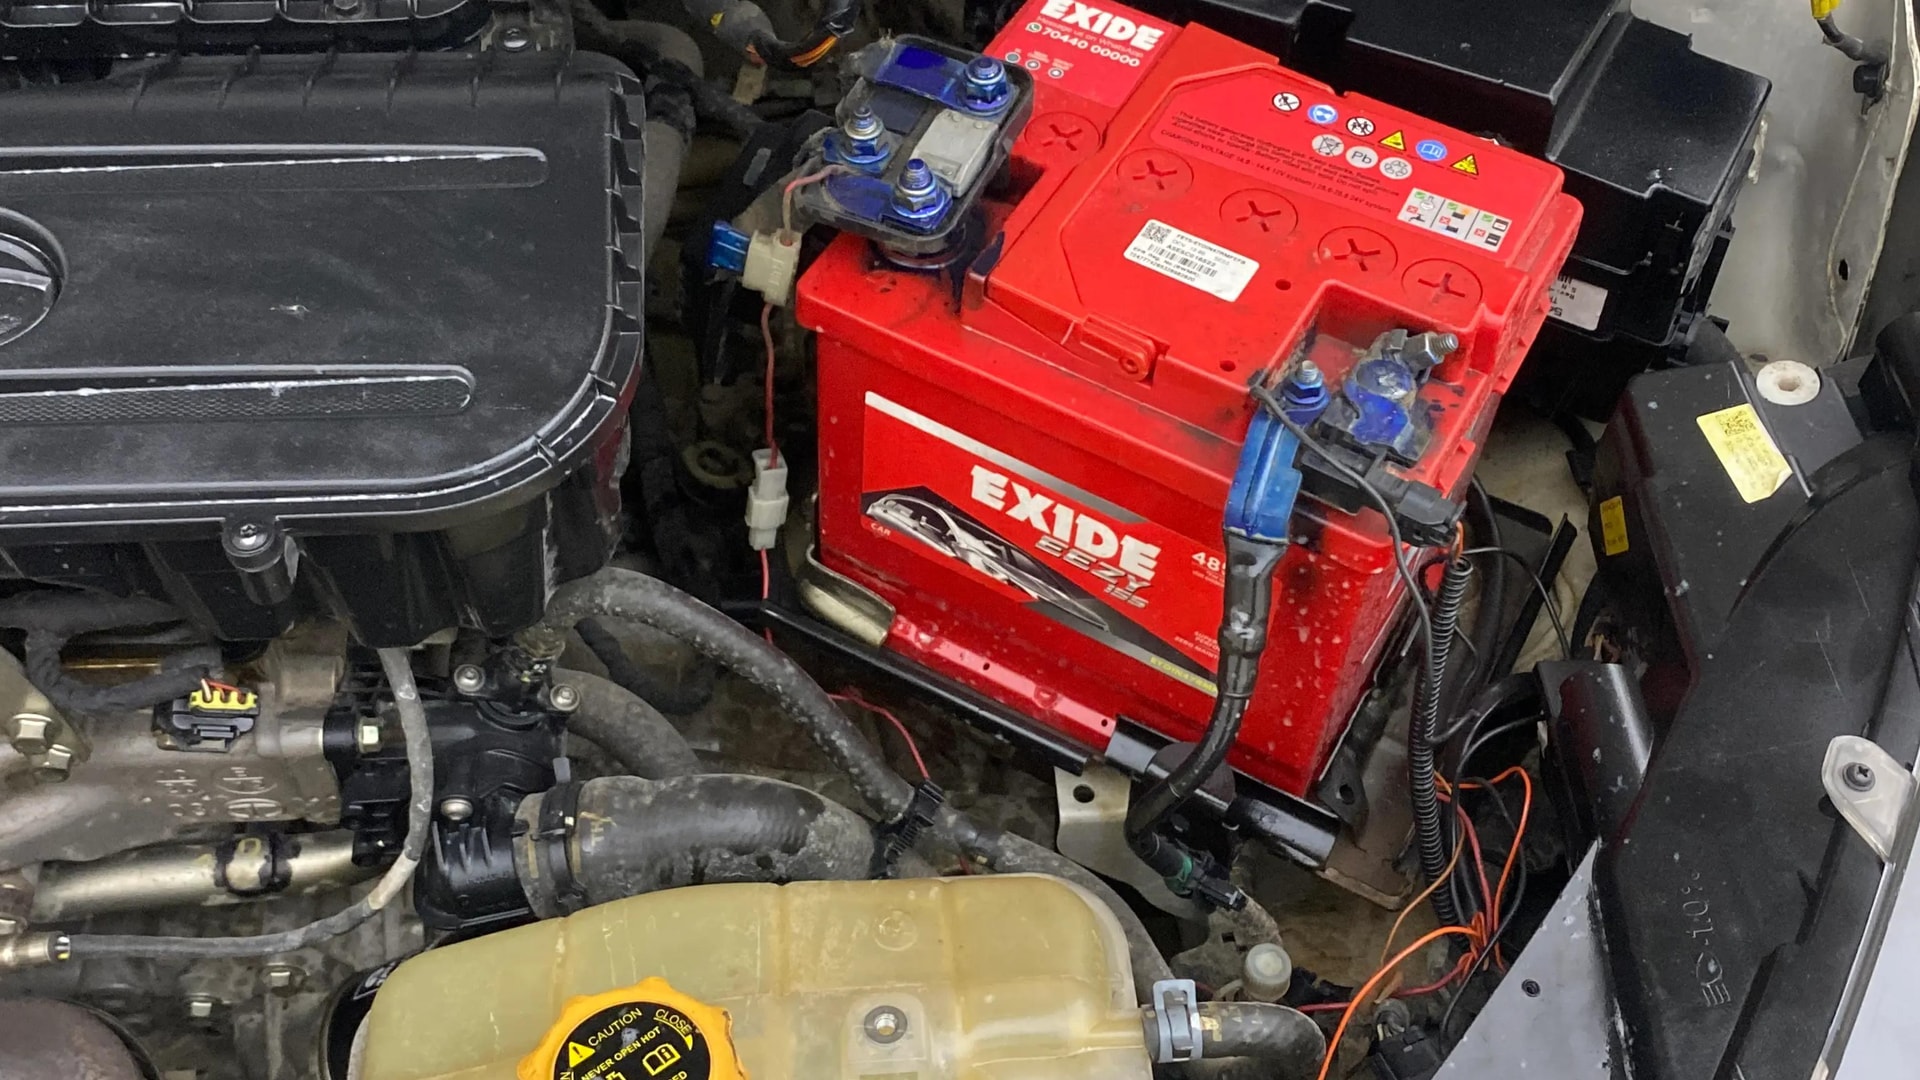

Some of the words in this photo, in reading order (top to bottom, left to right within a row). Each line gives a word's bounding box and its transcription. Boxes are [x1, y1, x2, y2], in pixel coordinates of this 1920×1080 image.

[1040, 0, 1165, 51] EXIDE
[1042, 27, 1088, 49] 70440
[1090, 44, 1140, 67] 00000
[1098, 38, 1144, 58] WhatsApp
[1351, 150, 1373, 165] Pb
[870, 522, 892, 536] CAR
[970, 465, 1162, 580] EXIDE
[1034, 535, 1155, 593] EEZY
[1105, 584, 1150, 609] 155
[588, 1008, 643, 1047] CAUTION
[655, 1008, 693, 1037] CLOSE
[581, 1058, 615, 1080] NEVER
[614, 1038, 641, 1061] OPEN
[640, 1025, 662, 1045] HOT
